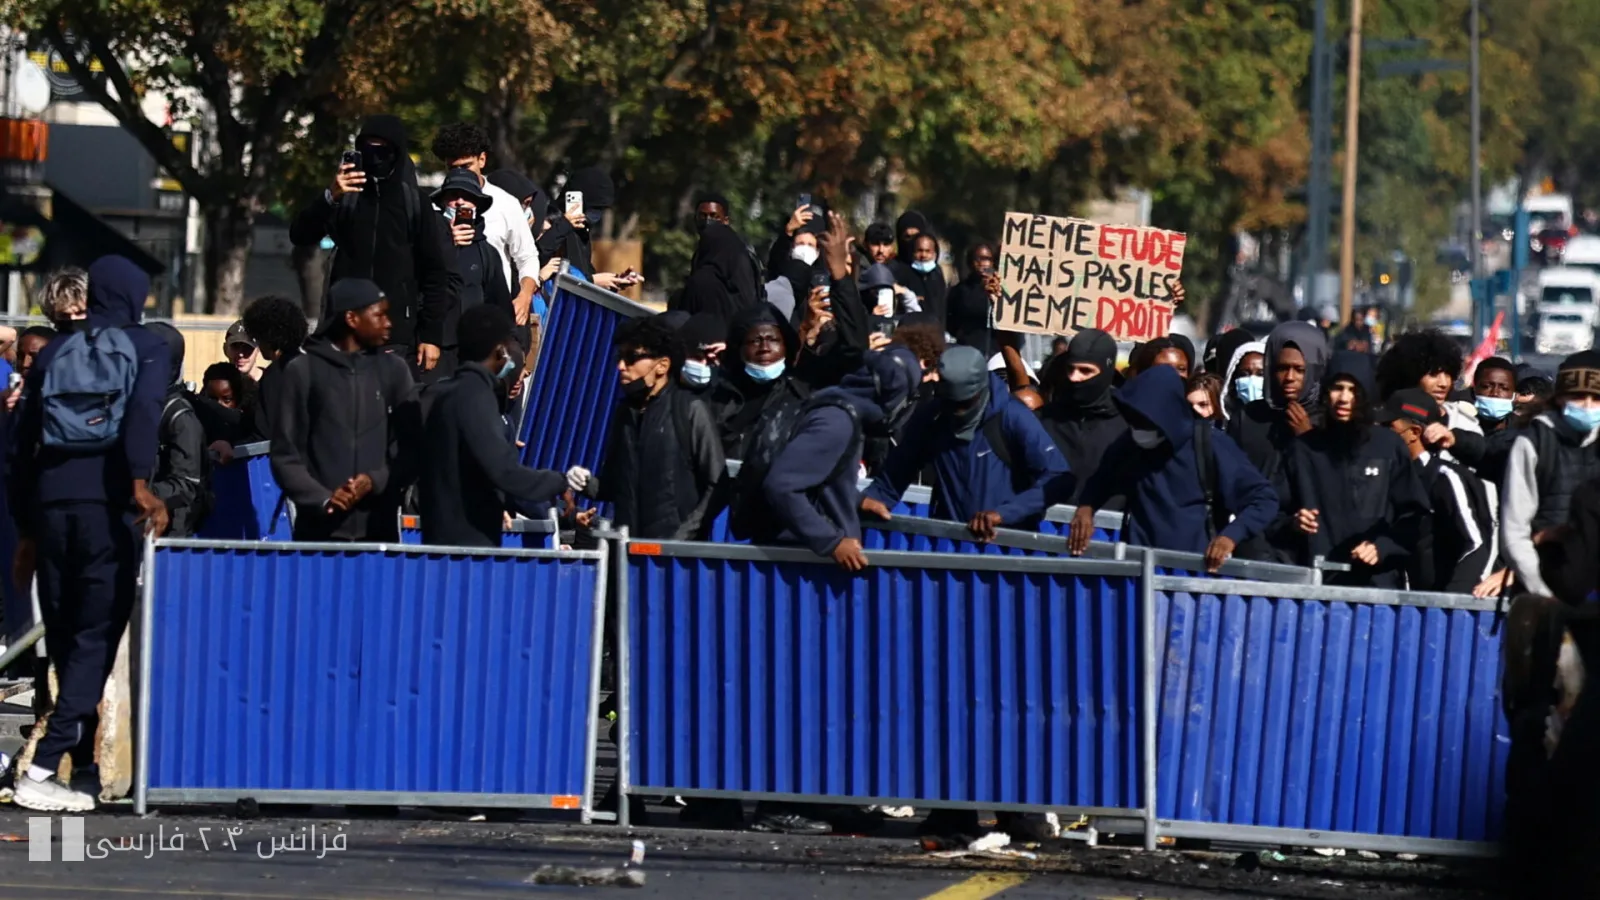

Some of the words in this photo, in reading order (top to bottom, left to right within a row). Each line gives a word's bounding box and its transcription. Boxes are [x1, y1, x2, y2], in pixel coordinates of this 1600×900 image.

[1098, 224, 1186, 271] ETUDE
[1083, 260, 1132, 293] PAS
[1133, 266, 1177, 301] LES
[995, 283, 1092, 331] MÊME
